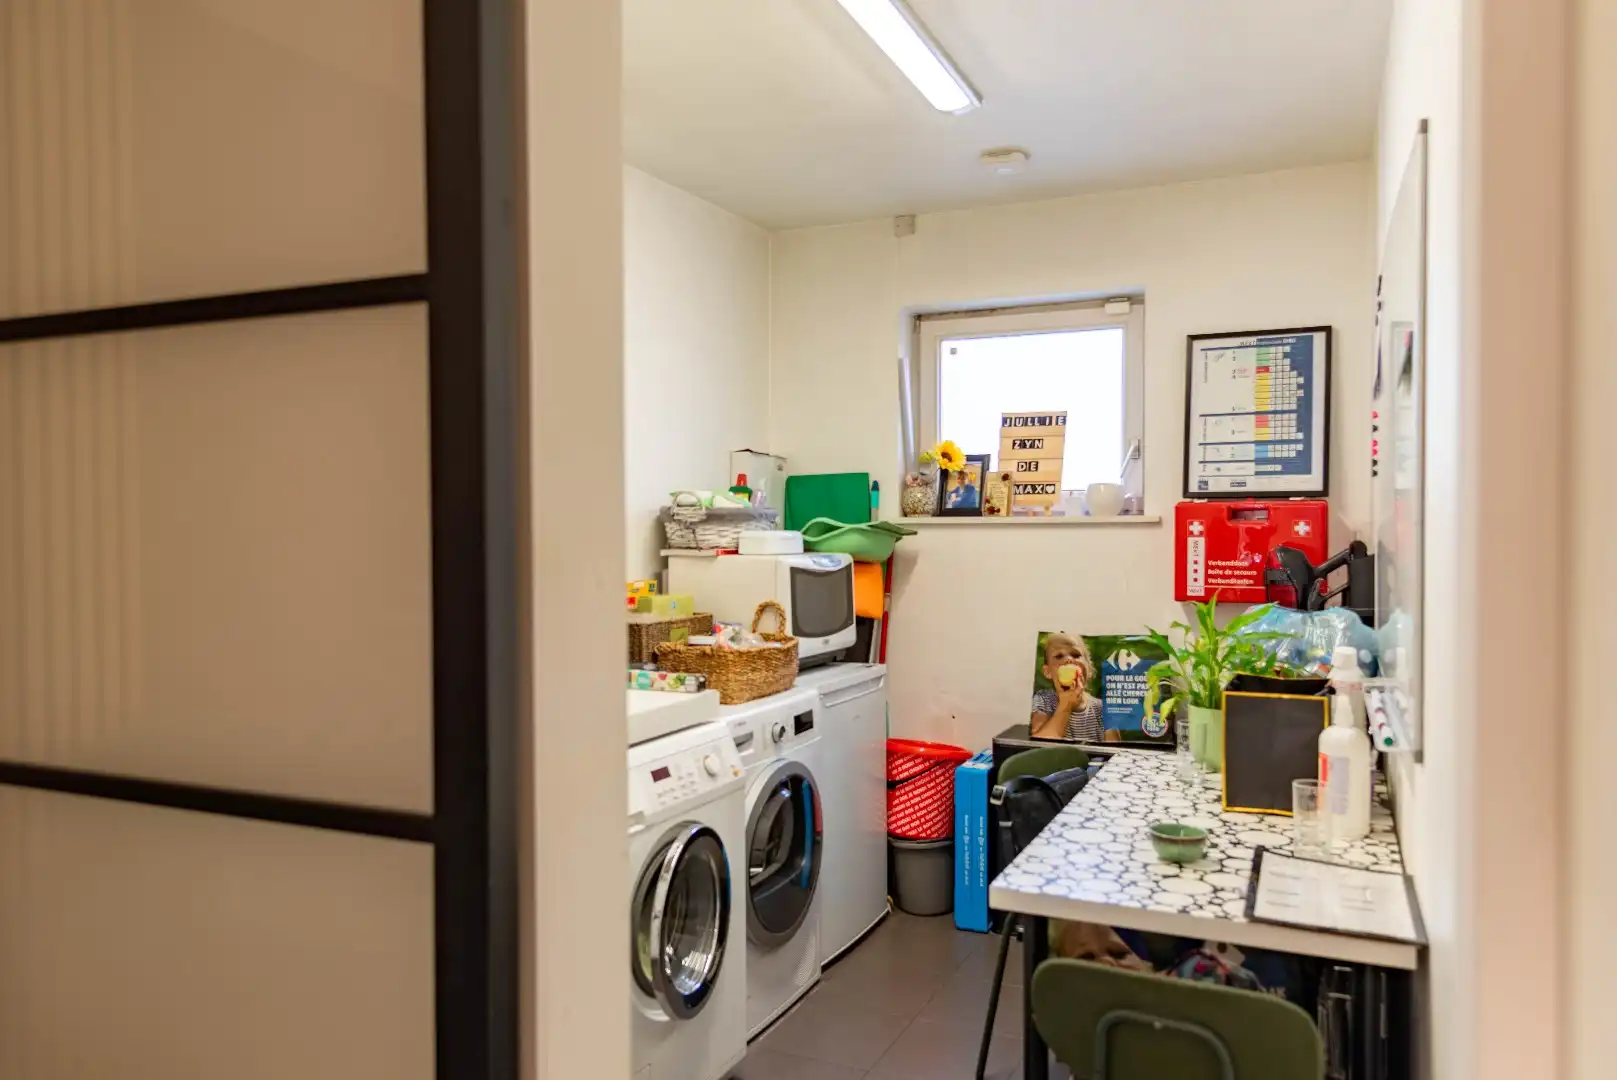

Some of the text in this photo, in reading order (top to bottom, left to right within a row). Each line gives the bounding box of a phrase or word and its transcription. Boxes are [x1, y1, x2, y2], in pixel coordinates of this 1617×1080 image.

[1003, 416, 1065, 427] JULLIE
[1013, 439, 1043, 450] ZYN
[1018, 462, 1038, 472] DE
[1014, 484, 1044, 495] MAX
